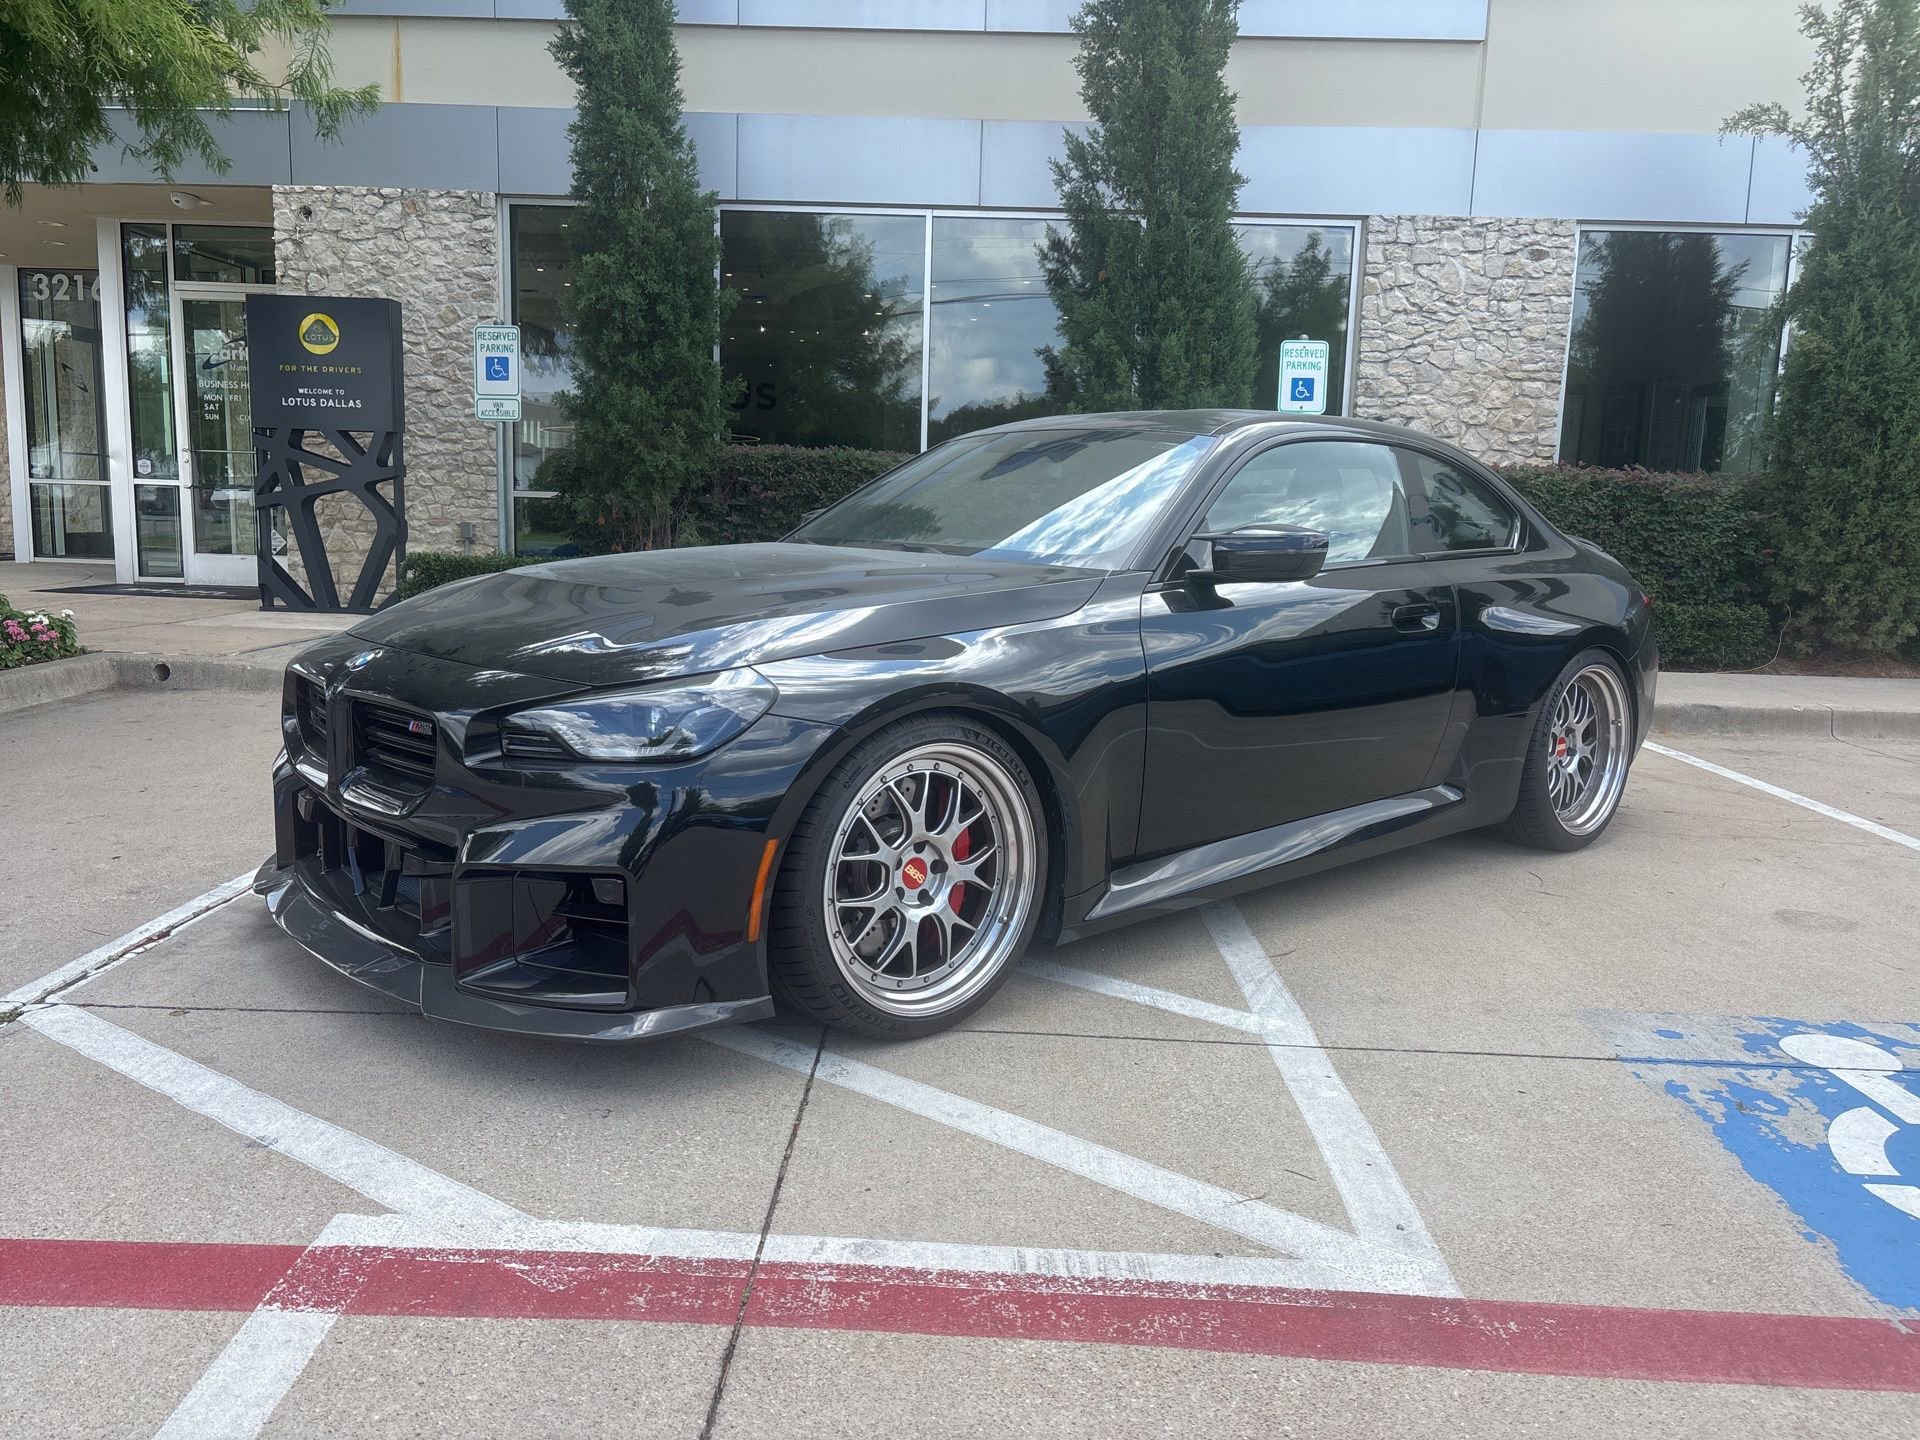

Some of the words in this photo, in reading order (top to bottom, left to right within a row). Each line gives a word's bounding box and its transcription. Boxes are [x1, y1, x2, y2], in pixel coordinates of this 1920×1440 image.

[477, 331, 517, 341] RESERVED
[480, 343, 514, 353] PARKING
[1285, 349, 1325, 358] RESERVED
[279, 364, 297, 372] FOR
[301, 365, 319, 373] THE
[322, 365, 362, 374] DRIVERS
[1287, 361, 1322, 371] PARKING
[198, 379, 239, 389] BUSINESS
[298, 387, 333, 395] WELCOME
[203, 394, 223, 402] MON
[229, 394, 242, 402] FRI
[282, 397, 317, 407] LOTUS
[320, 398, 362, 408] DALLAS
[203, 403, 220, 411] SAT
[493, 401, 504, 409] VAN
[204, 413, 220, 421] SUN
[480, 409, 516, 418] ACCESSIBLE
[977, 733, 1028, 782] MICHELIN
[904, 864, 926, 884] BBS
